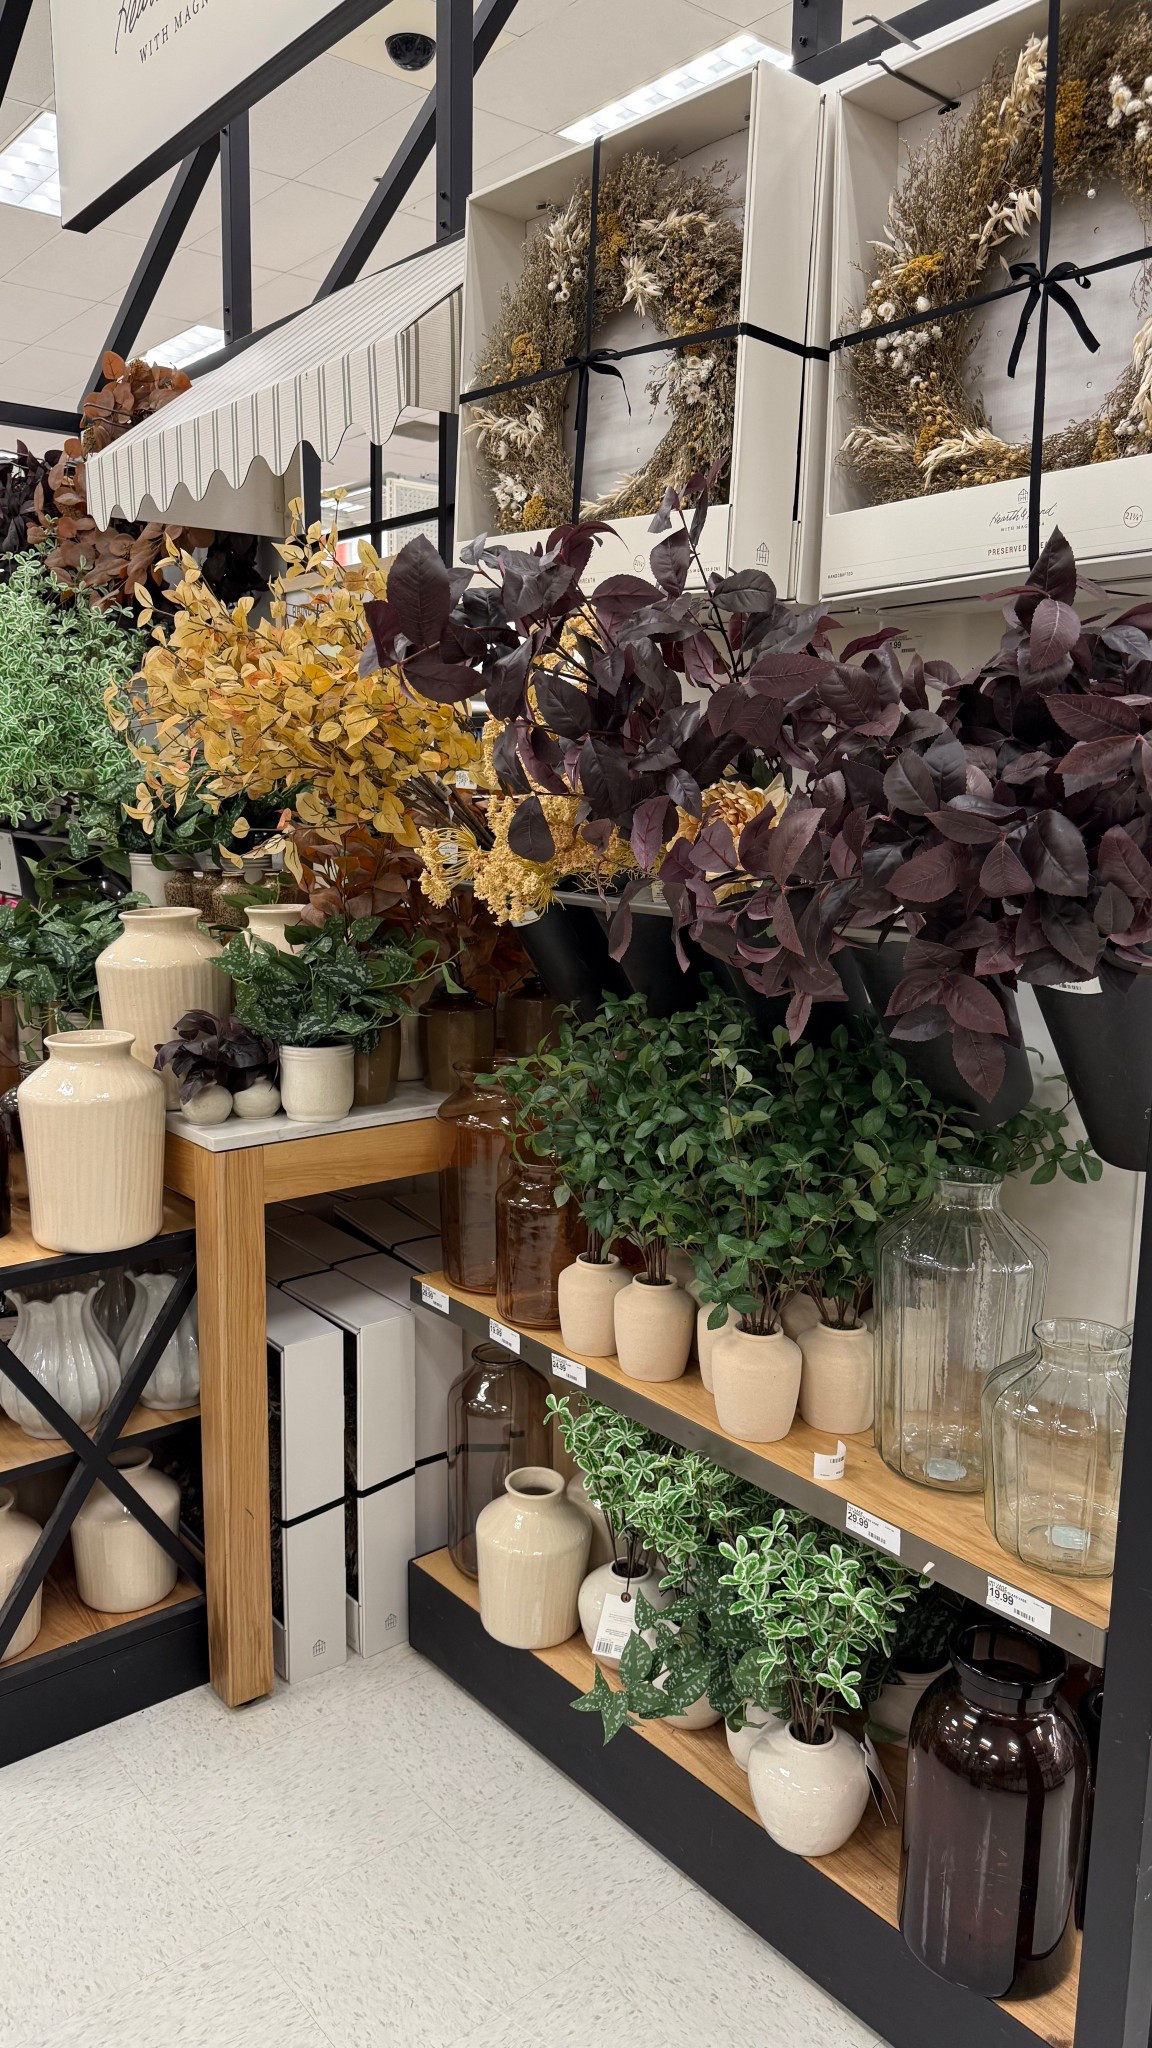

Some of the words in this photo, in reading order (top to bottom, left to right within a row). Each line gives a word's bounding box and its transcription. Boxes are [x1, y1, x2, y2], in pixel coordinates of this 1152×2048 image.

[139, 24, 169, 64] WITH
[987, 544, 1027, 556] PRESERVED
[847, 1511, 869, 1529] 29.99
[989, 1587, 1014, 1606] 19.99
